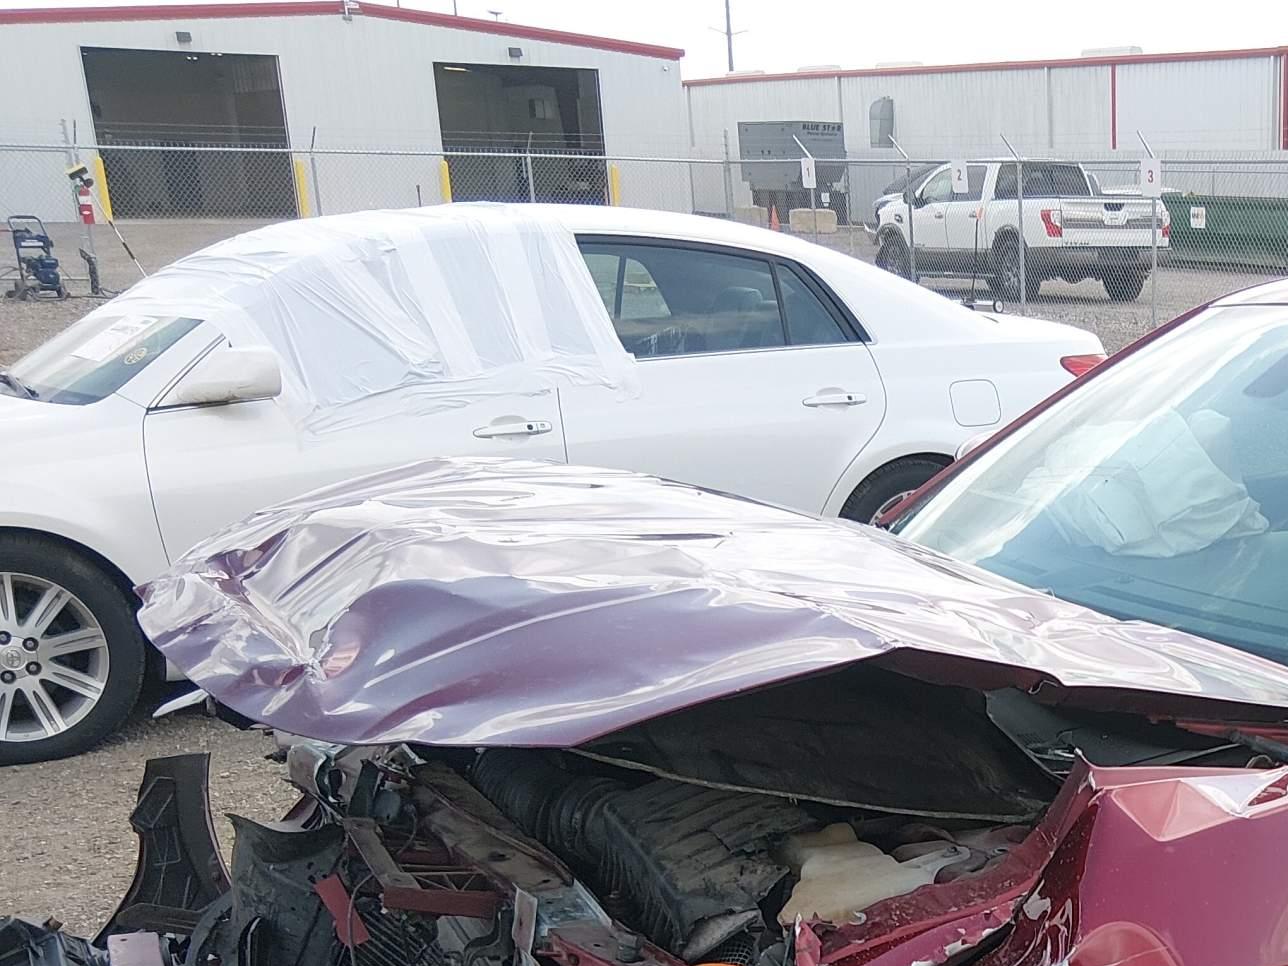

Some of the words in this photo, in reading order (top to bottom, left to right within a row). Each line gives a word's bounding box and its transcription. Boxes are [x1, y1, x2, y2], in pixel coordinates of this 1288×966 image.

[805, 167, 810, 177] 1
[957, 169, 963, 181] 2
[1147, 169, 1154, 183] 3
